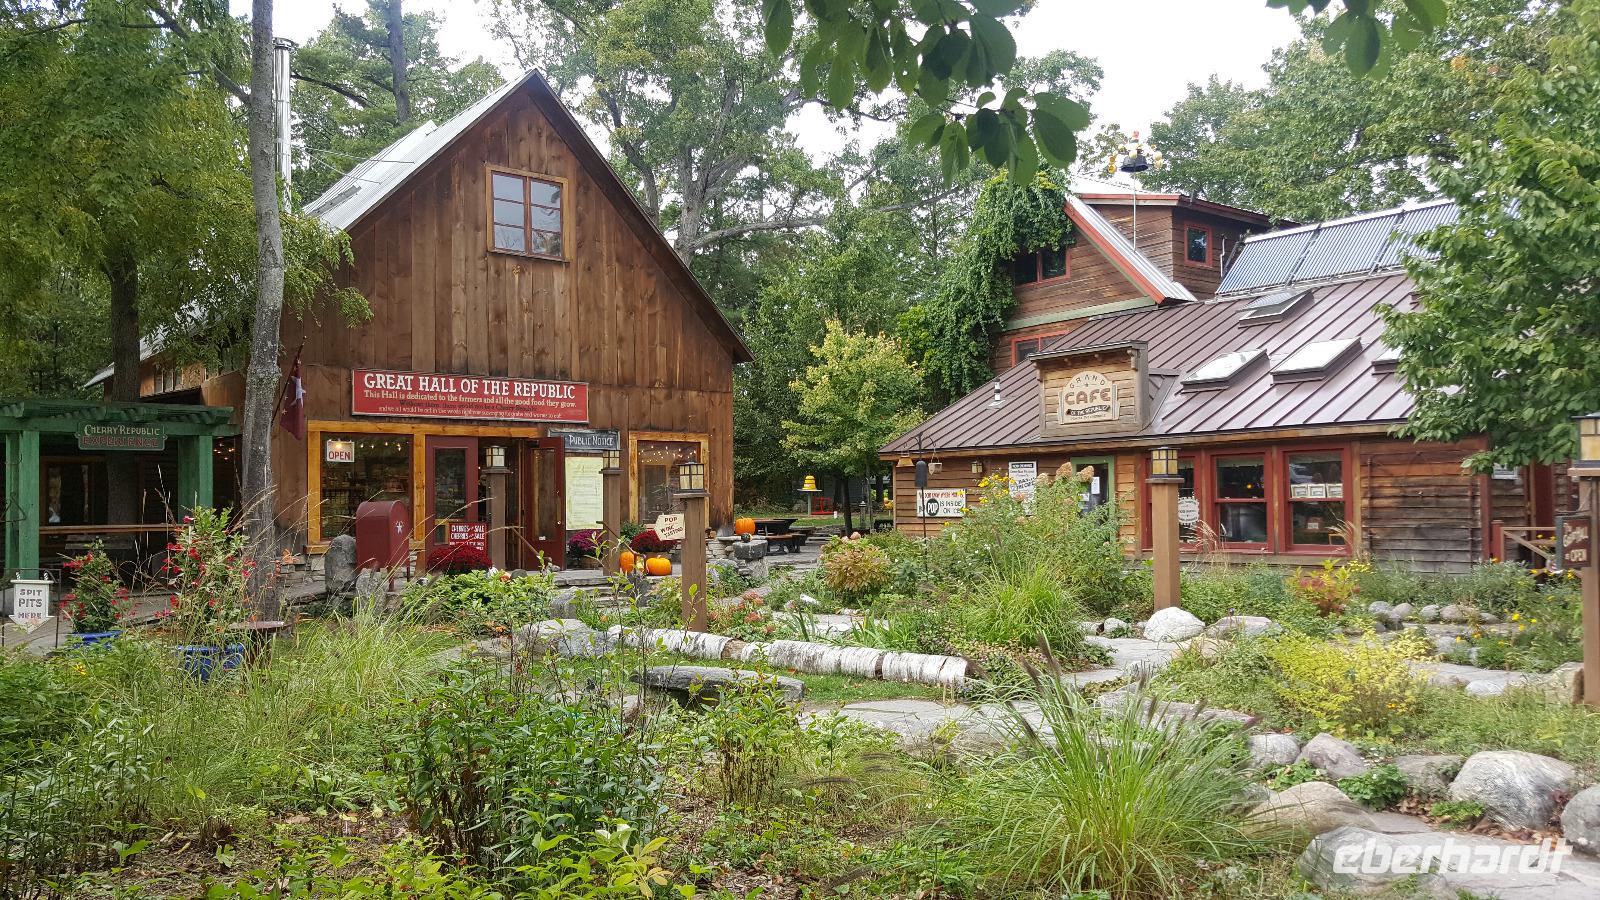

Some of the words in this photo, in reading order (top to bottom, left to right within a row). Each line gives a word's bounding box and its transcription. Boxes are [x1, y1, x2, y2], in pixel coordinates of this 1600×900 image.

[364, 373, 414, 390] GREAT
[419, 376, 456, 393] HALL
[461, 378, 479, 394] OF
[482, 380, 510, 396] THE
[514, 381, 576, 399] REPUBLIC
[1070, 374, 1106, 388] GRAND
[364, 389, 380, 398] This
[381, 390, 398, 399] Hall
[399, 391, 405, 400] is
[406, 391, 438, 401] dedicated
[438, 392, 446, 401] to
[447, 393, 458, 402] the
[459, 394, 482, 403] farmers
[483, 395, 495, 404] and
[495, 396, 504, 404] all
[504, 396, 514, 405] the
[515, 396, 530, 406] good
[531, 397, 545, 406] food
[546, 399, 560, 409] they
[560, 401, 577, 409] grow.
[84, 424, 118, 436] CHERRY
[118, 424, 160, 436] REPUBLIC
[83, 435, 159, 448] EXPERIENCE
[568, 434, 591, 446] PUBLIC
[592, 435, 613, 446] NOTICE
[328, 451, 351, 460] OPEN
[20, 588, 43, 596] SPIT
[18, 598, 43, 608] PITS
[18, 612, 42, 620] HERE
